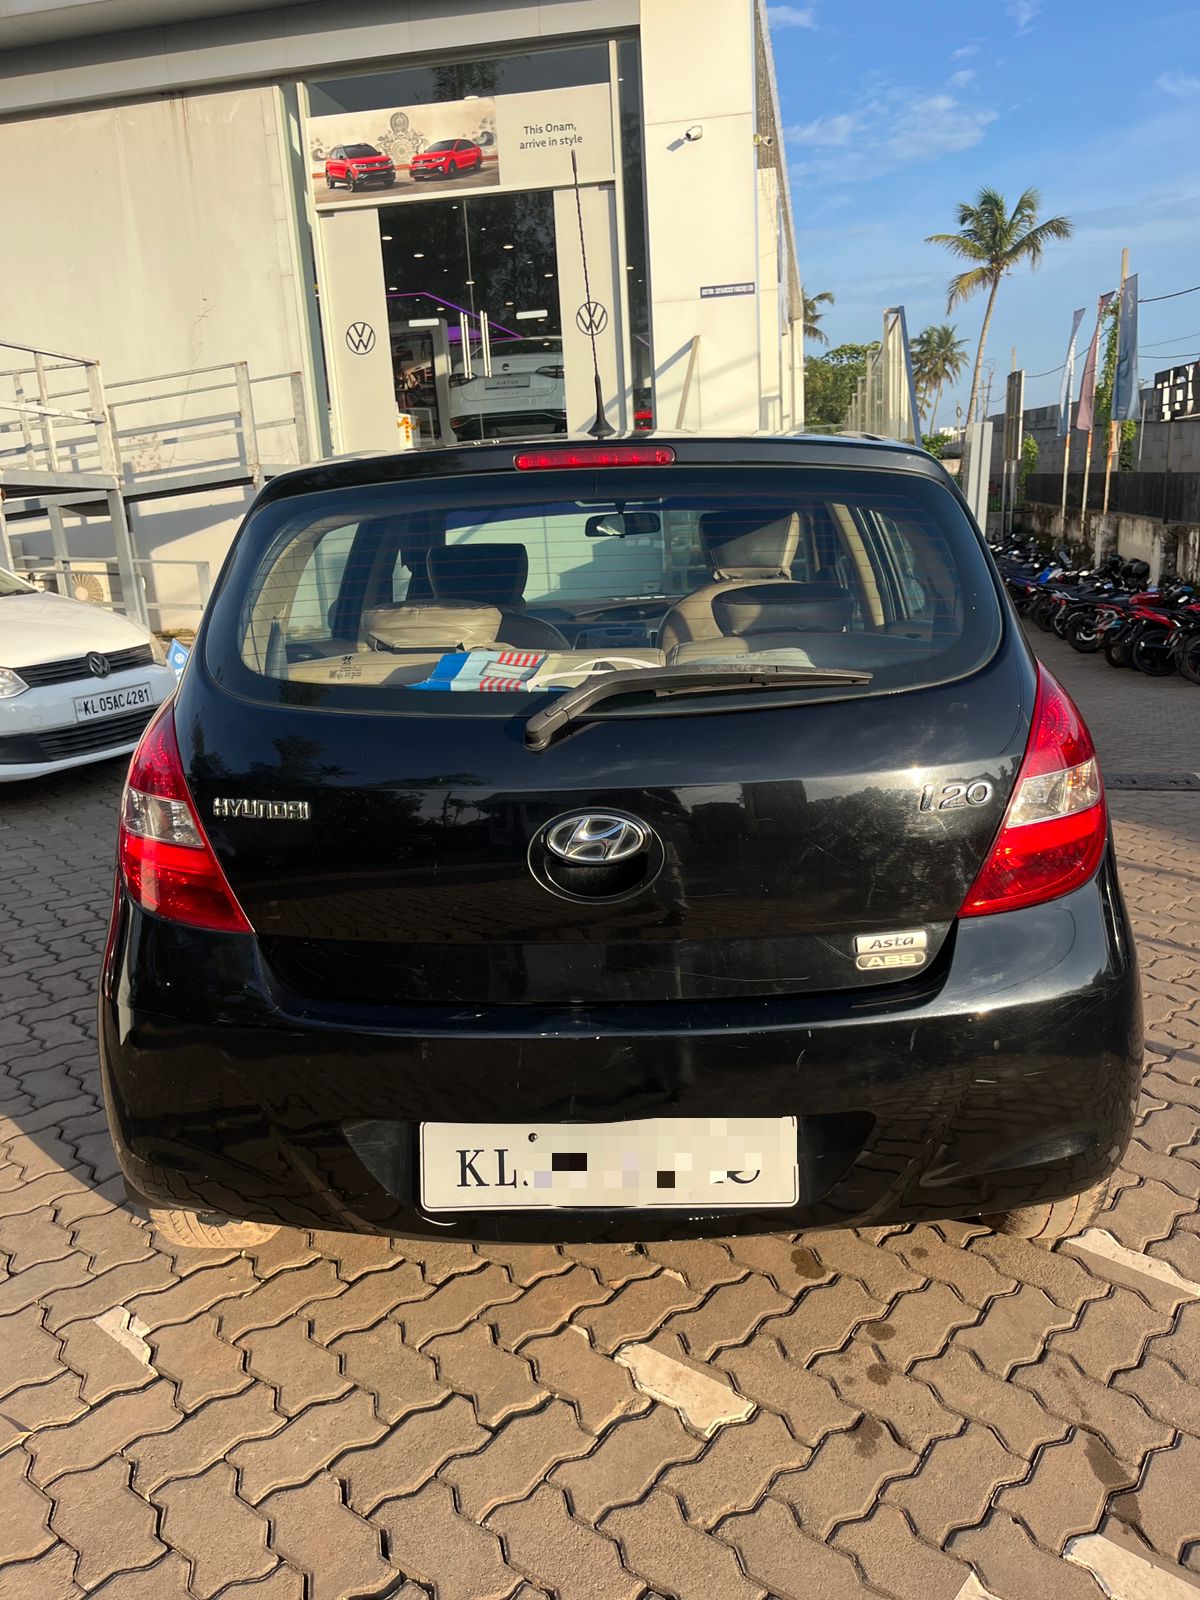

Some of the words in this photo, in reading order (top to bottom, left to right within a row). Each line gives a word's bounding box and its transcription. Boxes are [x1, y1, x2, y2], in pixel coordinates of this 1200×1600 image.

[524, 125, 543, 135] This
[545, 123, 577, 133] Onam,
[520, 139, 546, 150] arrive
[548, 137, 558, 147] in
[560, 134, 583, 147] style
[920, 781, 993, 812] i20
[213, 798, 309, 819] HYUNDAI
[870, 936, 915, 950] Asta
[866, 953, 917, 968] ABS
